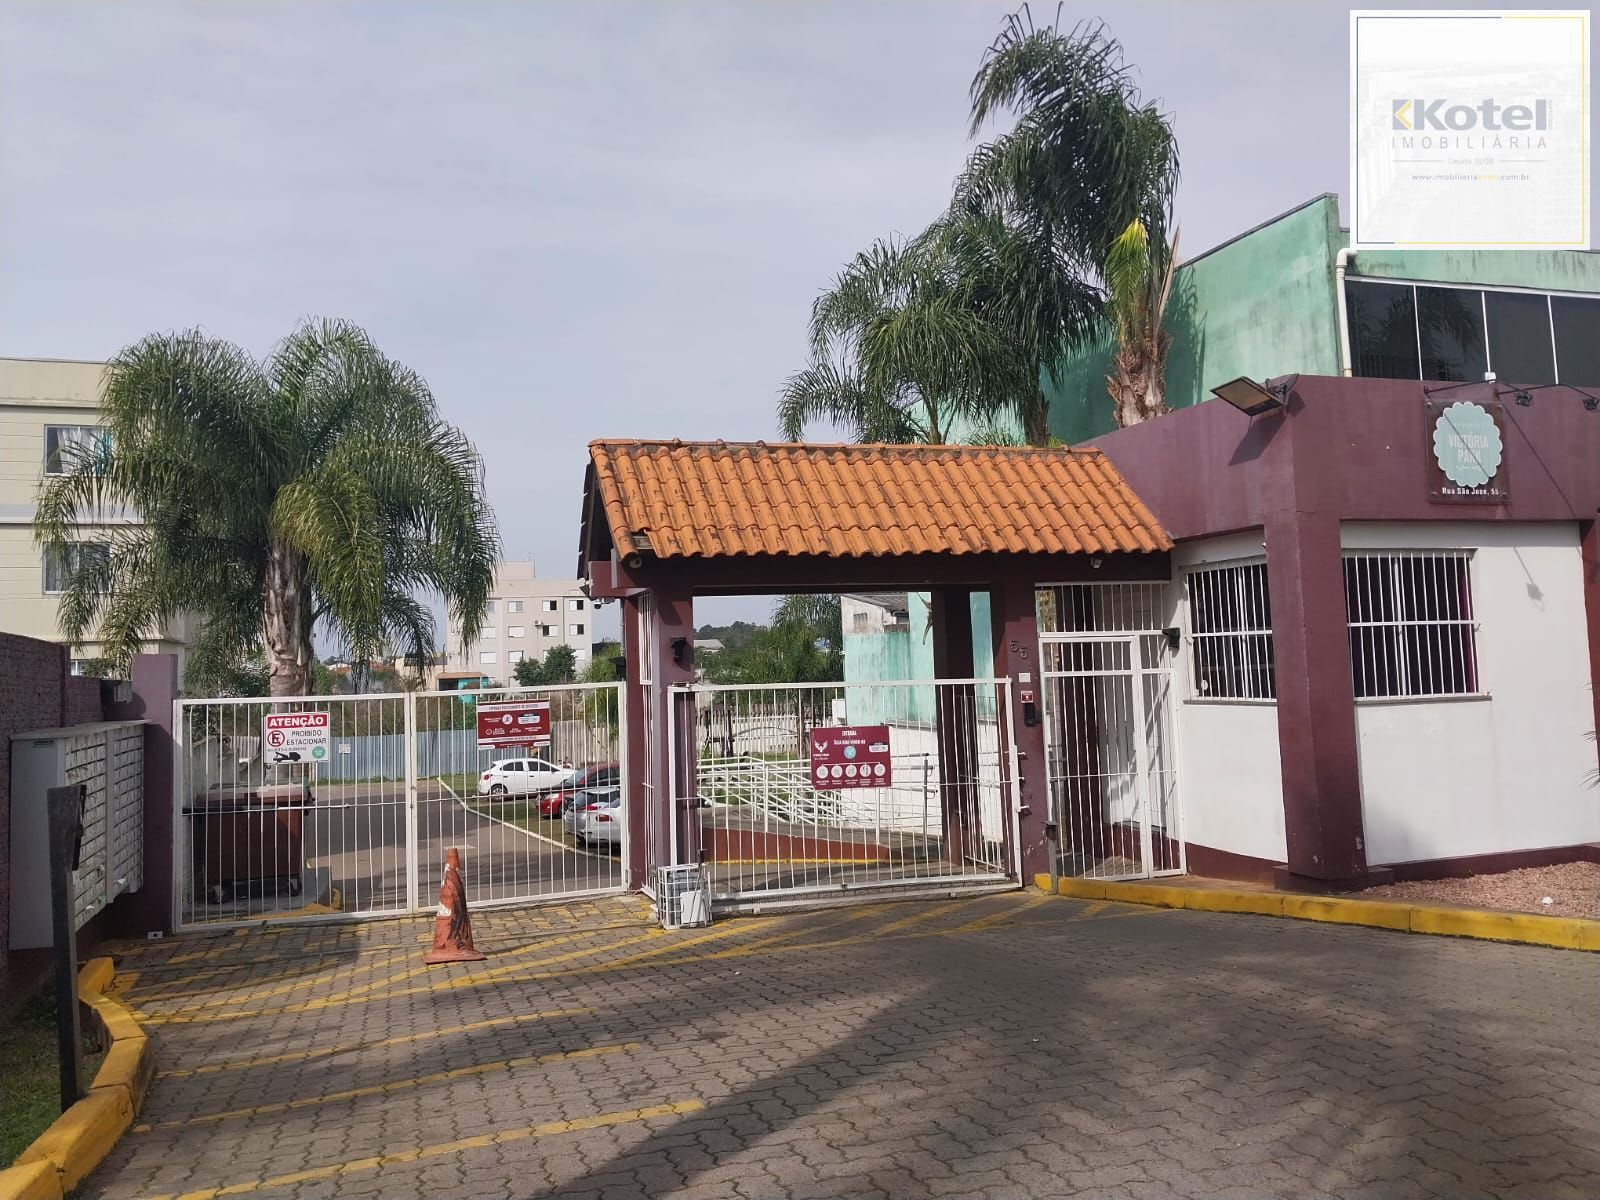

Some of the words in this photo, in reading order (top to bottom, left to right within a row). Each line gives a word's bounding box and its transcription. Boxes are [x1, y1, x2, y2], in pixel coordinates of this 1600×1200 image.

[1457, 449, 1482, 464] PARK
[1442, 487, 1455, 495] Rua
[269, 715, 324, 727] ATENÇÃO
[291, 729, 322, 737] PROIBIDO
[286, 738, 327, 746] ESTACIONAR
